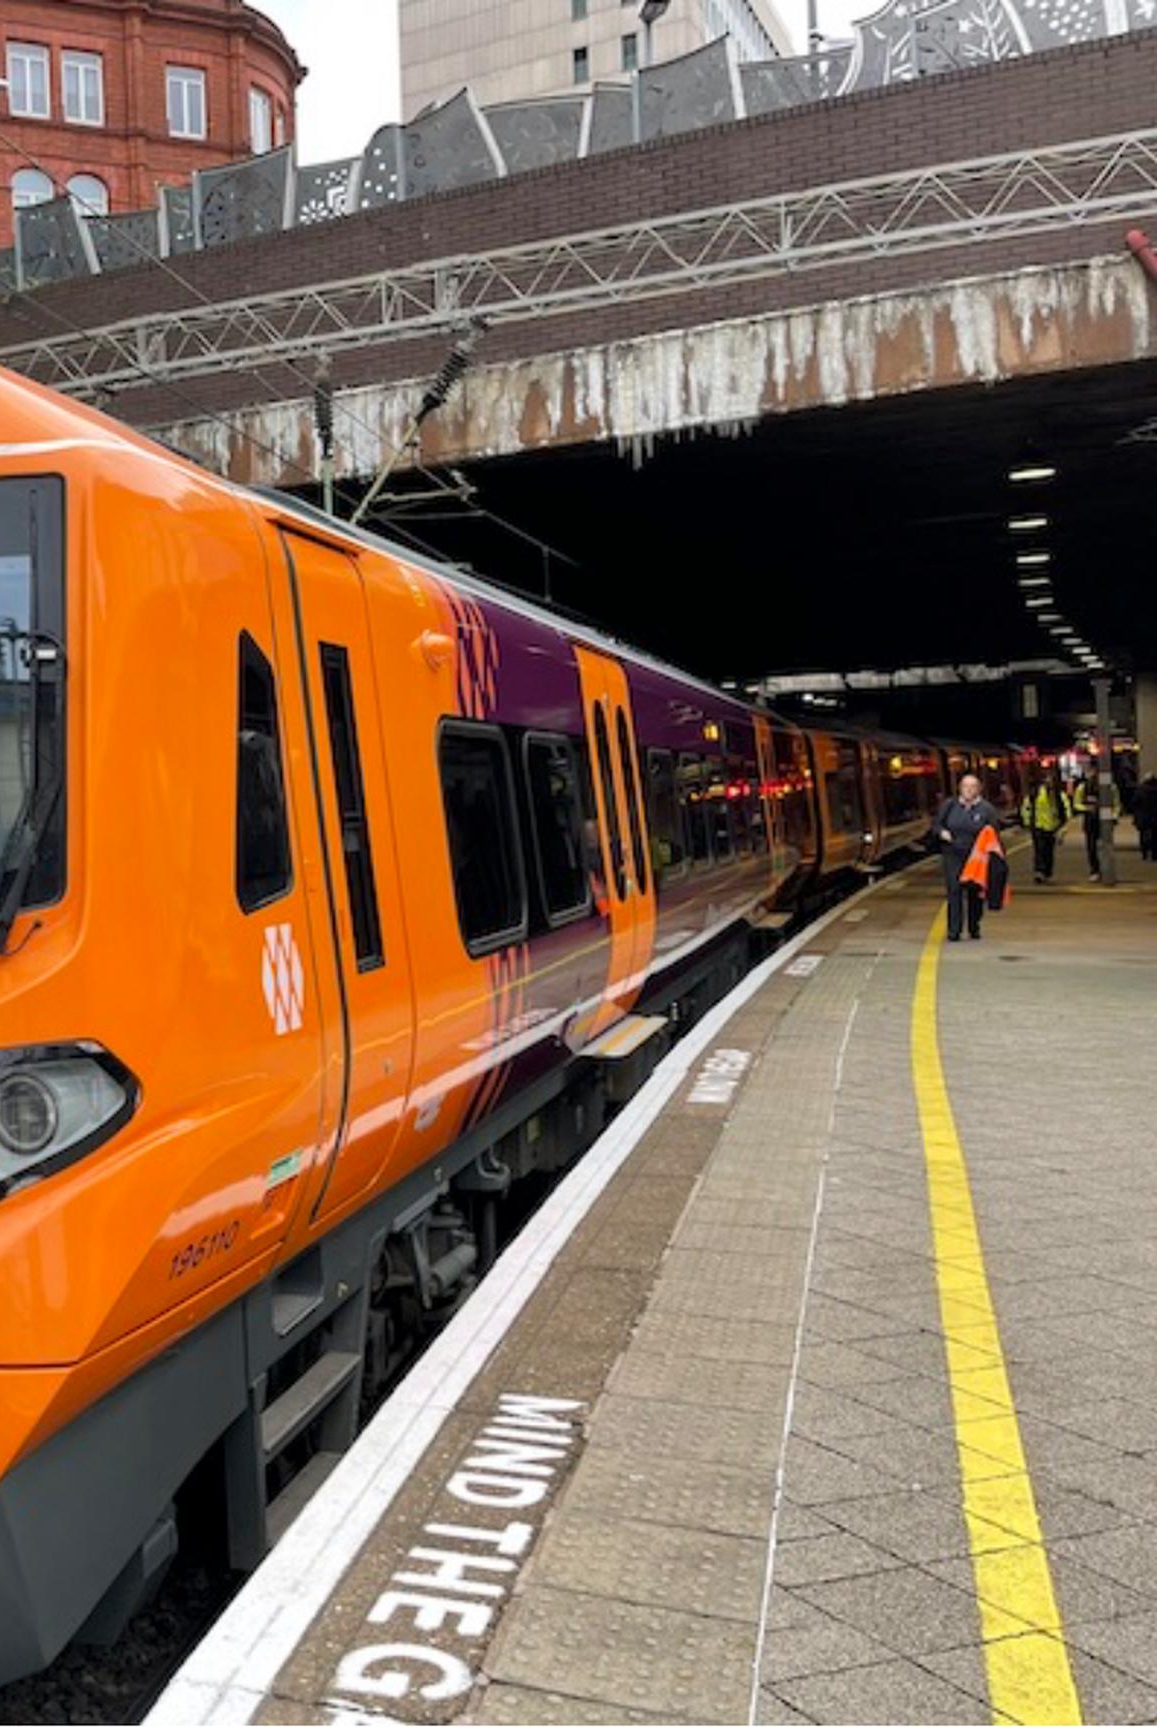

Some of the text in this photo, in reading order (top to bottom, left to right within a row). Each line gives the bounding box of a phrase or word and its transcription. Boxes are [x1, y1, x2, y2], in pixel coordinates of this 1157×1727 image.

[168, 1219, 241, 1281] 196110
[445, 1393, 589, 1508] MIND
[366, 1521, 534, 1637] THE
